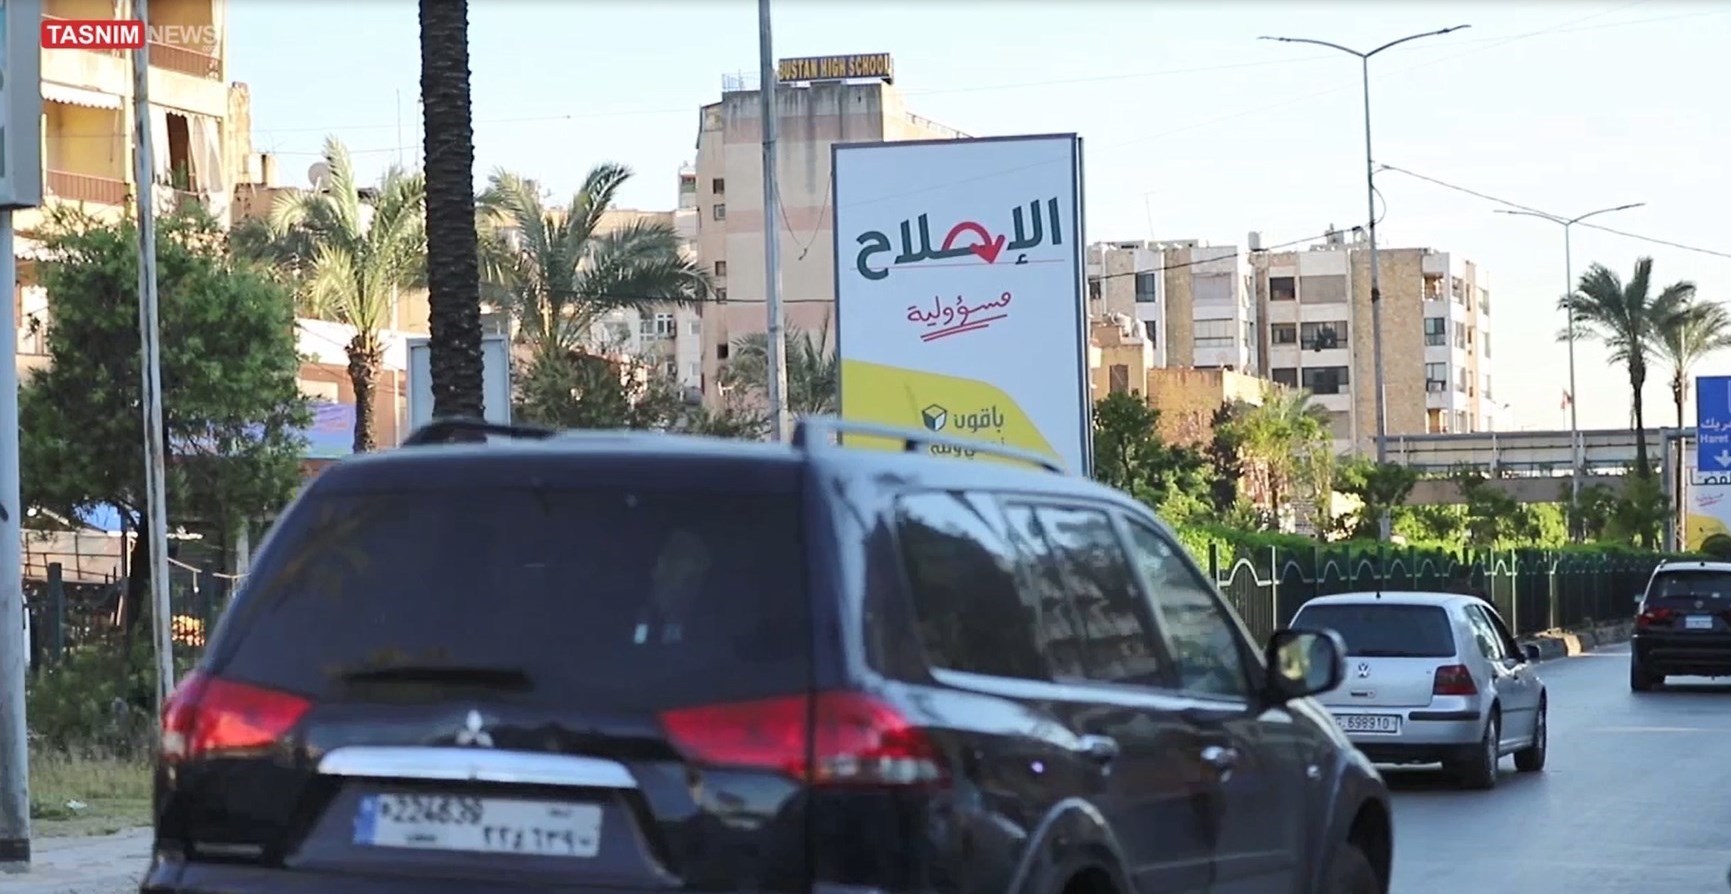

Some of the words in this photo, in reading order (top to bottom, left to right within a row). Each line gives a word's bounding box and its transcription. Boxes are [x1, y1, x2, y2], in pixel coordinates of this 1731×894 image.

[820, 57, 846, 77] HIGH
[848, 54, 889, 76] SCHOOL
[856, 196, 1062, 280] الإصلاح
[907, 291, 1012, 326] مسؤولية
[953, 405, 1004, 433] باقون
